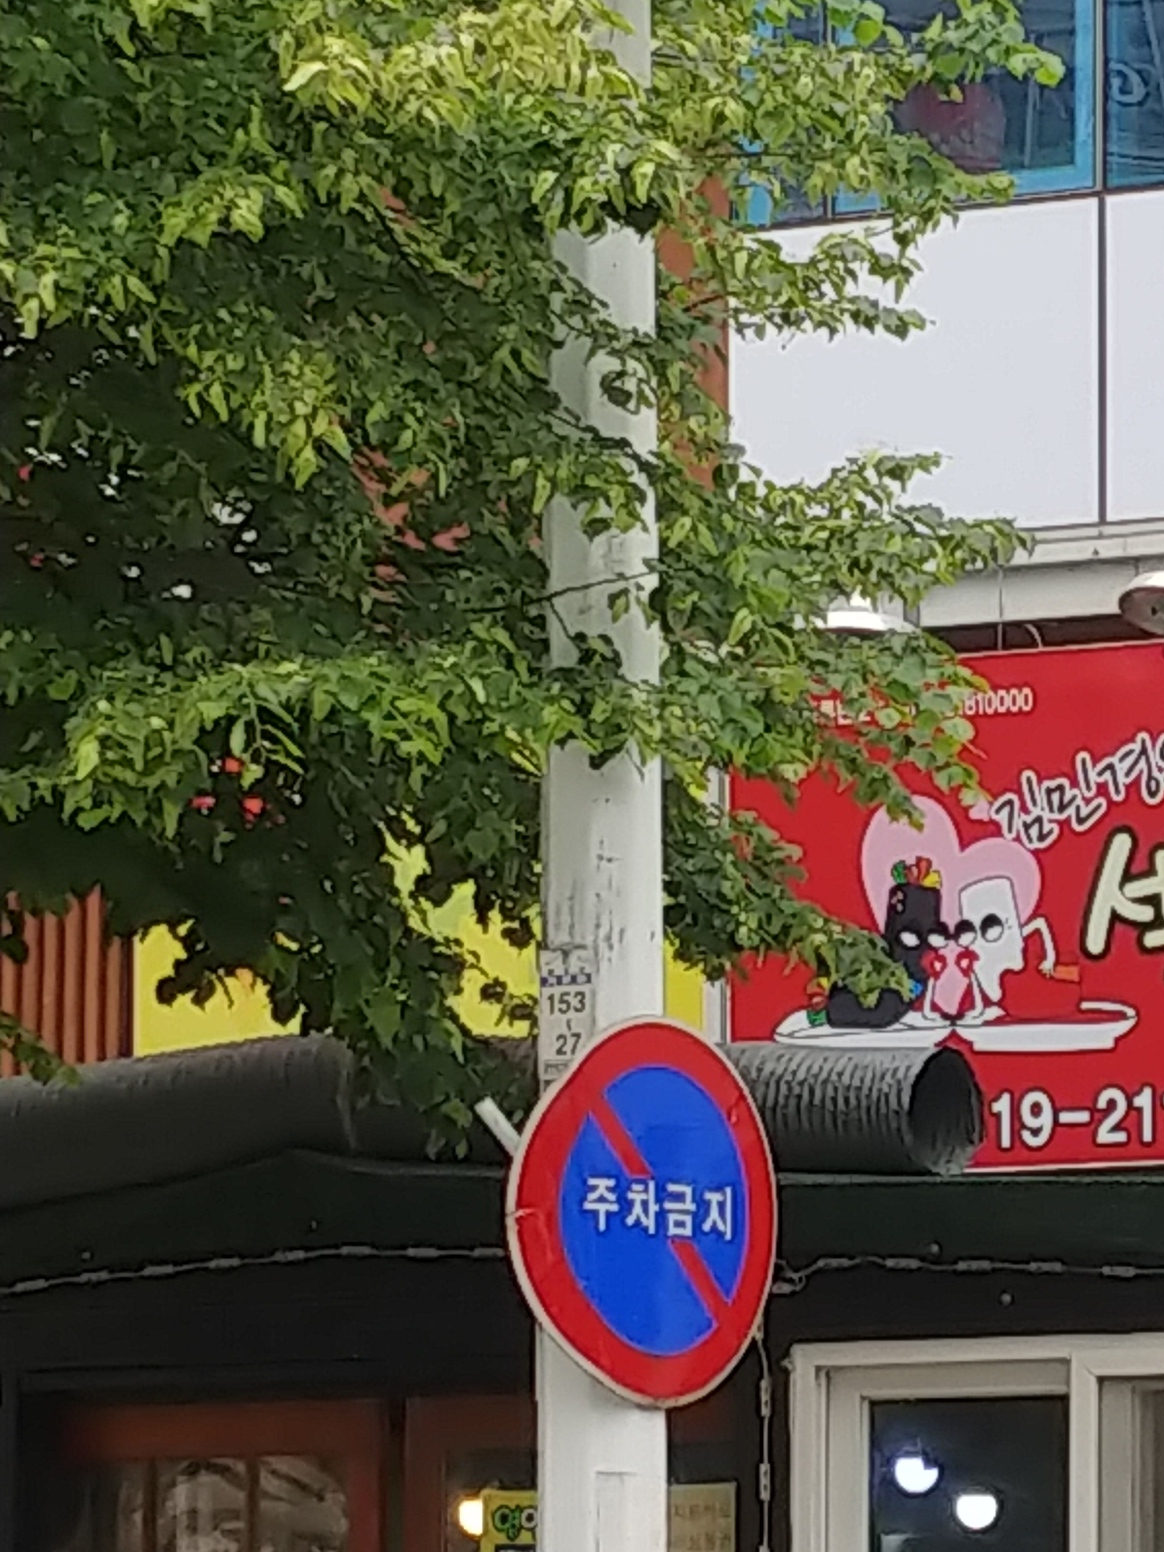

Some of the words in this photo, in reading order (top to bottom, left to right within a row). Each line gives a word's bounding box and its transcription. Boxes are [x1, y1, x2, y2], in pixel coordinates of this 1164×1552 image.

[547, 990, 586, 1015] 153
[555, 1032, 582, 1056] 27
[583, 1175, 734, 1241] 주차금지
